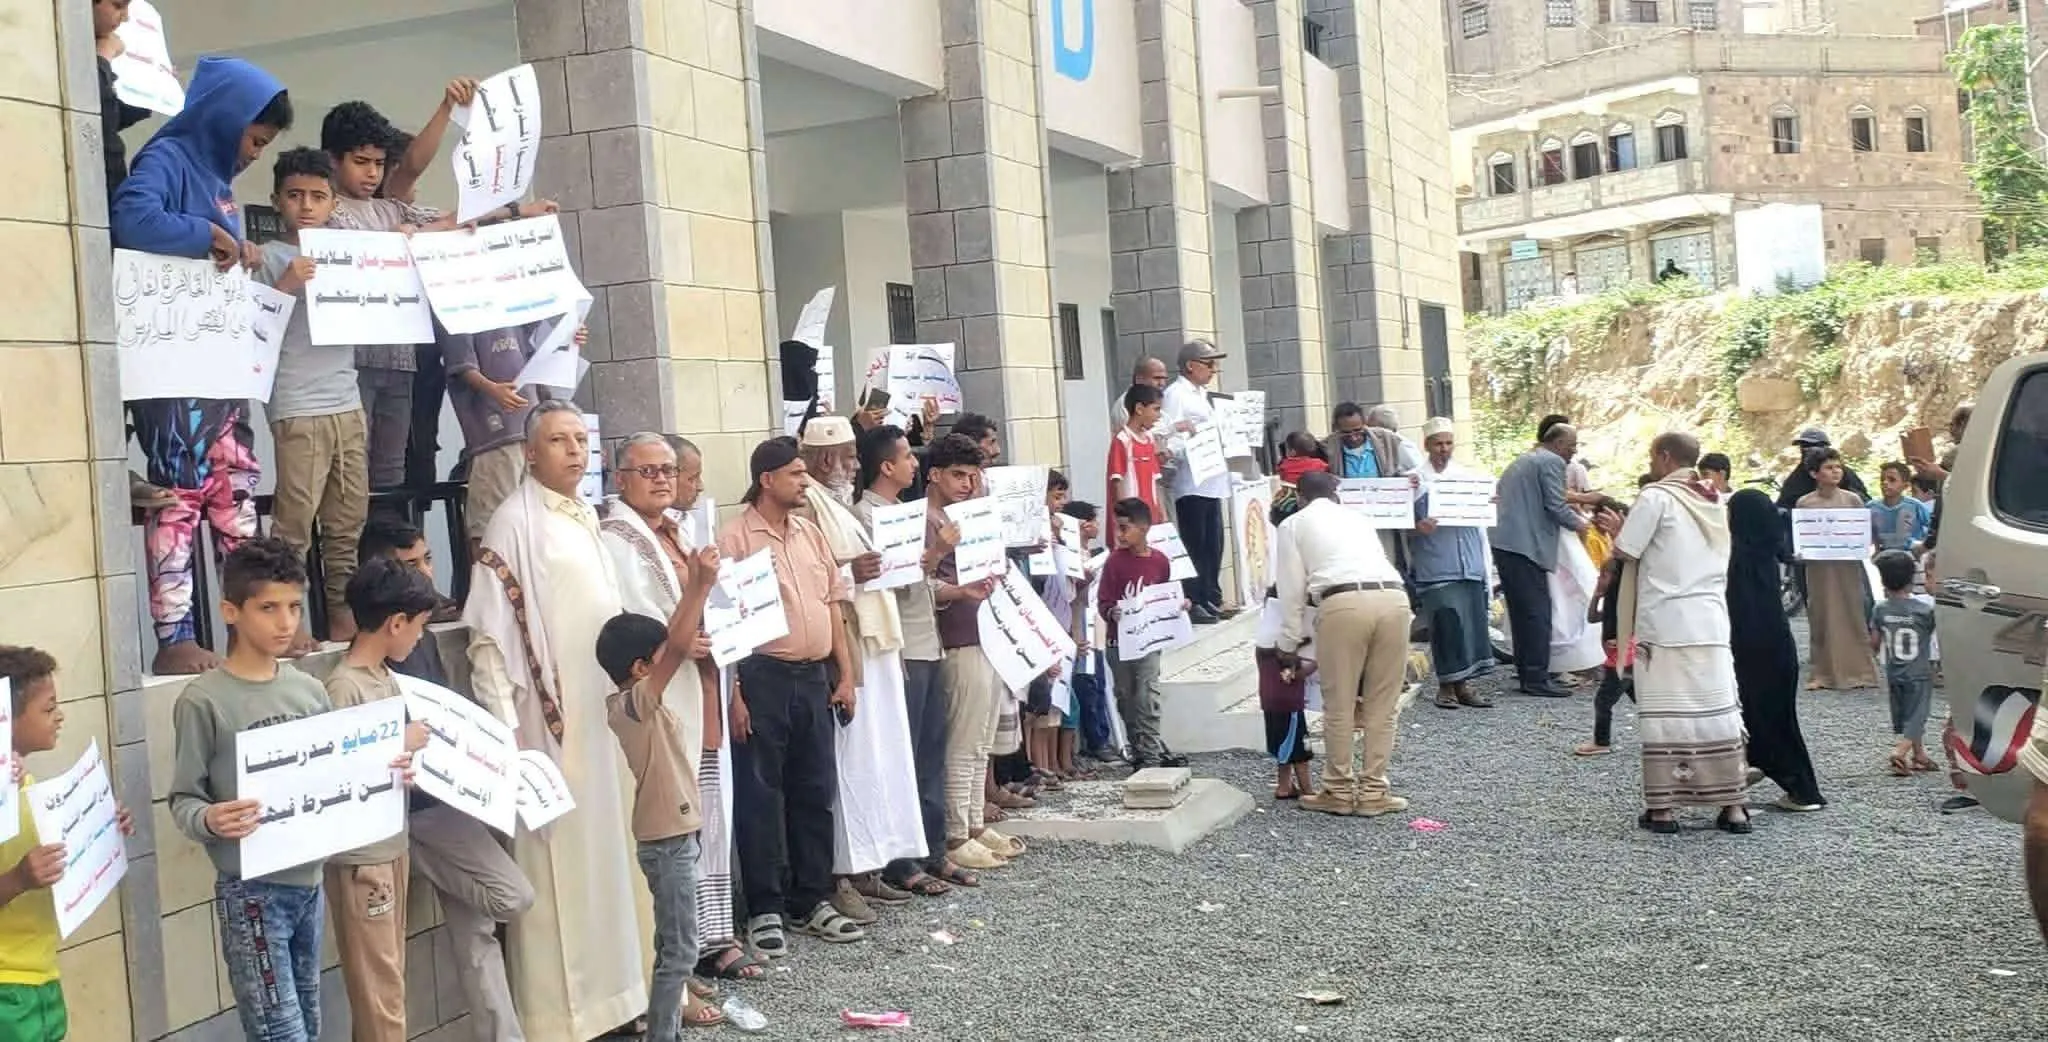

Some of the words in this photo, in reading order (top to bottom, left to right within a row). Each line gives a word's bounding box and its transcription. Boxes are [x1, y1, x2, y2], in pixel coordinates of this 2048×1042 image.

[393, 292, 420, 307] من
[245, 739, 335, 774] مدرستنا
[301, 780, 353, 815] نفرط
[358, 771, 395, 803] لن
[258, 796, 296, 826] فيه
